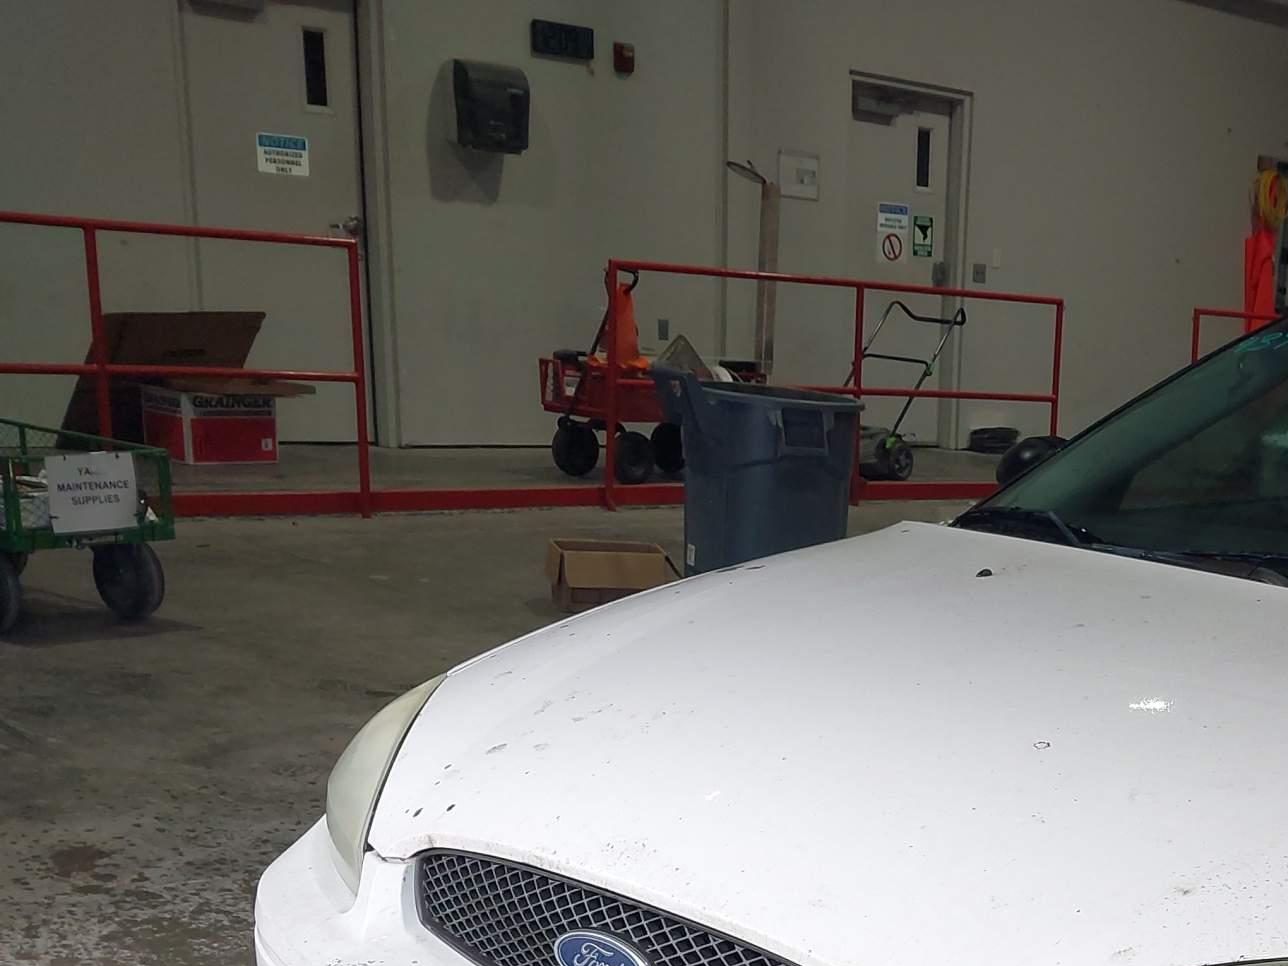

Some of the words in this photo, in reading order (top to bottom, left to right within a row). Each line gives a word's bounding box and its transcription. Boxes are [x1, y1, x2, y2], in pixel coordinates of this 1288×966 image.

[260, 136, 304, 149] NOTICE
[276, 166, 292, 174] ONLY
[193, 395, 274, 408] GRAINGER
[57, 480, 129, 493] MAINTENANCE
[72, 494, 120, 506] SUPPLIES
